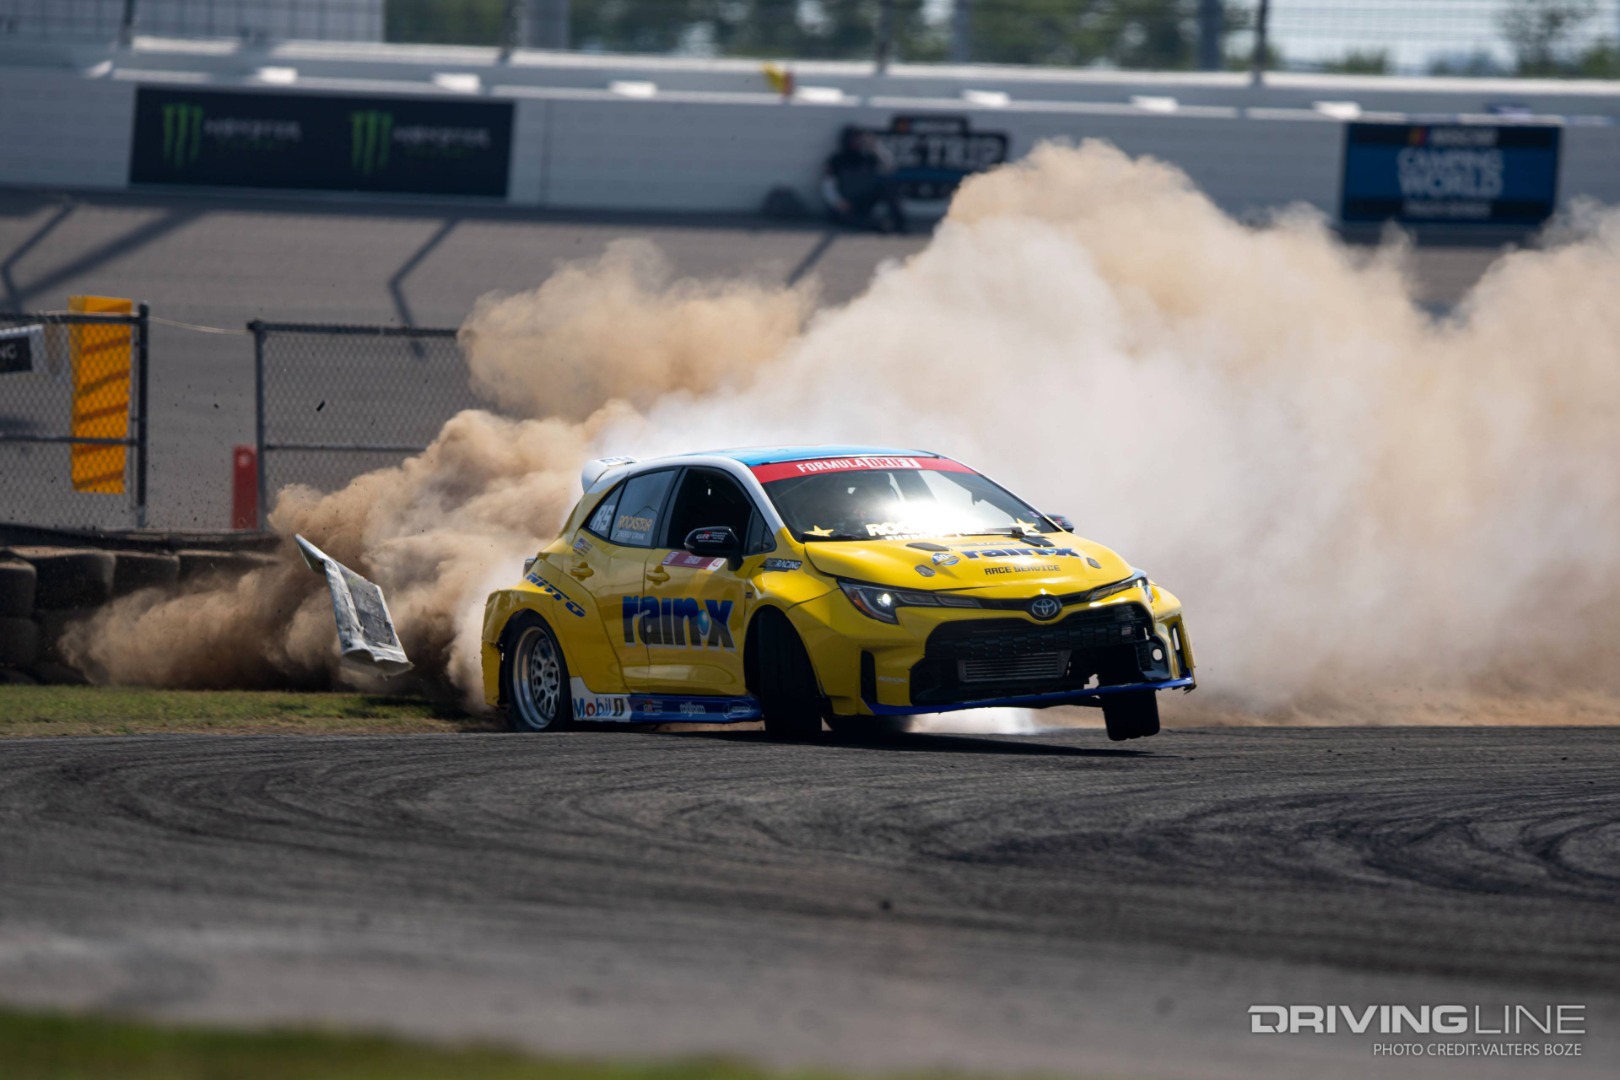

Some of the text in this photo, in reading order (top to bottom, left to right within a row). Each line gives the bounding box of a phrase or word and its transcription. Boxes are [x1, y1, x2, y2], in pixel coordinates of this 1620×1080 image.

[796, 458, 866, 472] FORMULA
[984, 564, 1061, 576] RACE SERVICE
[573, 697, 612, 718] Mobil
